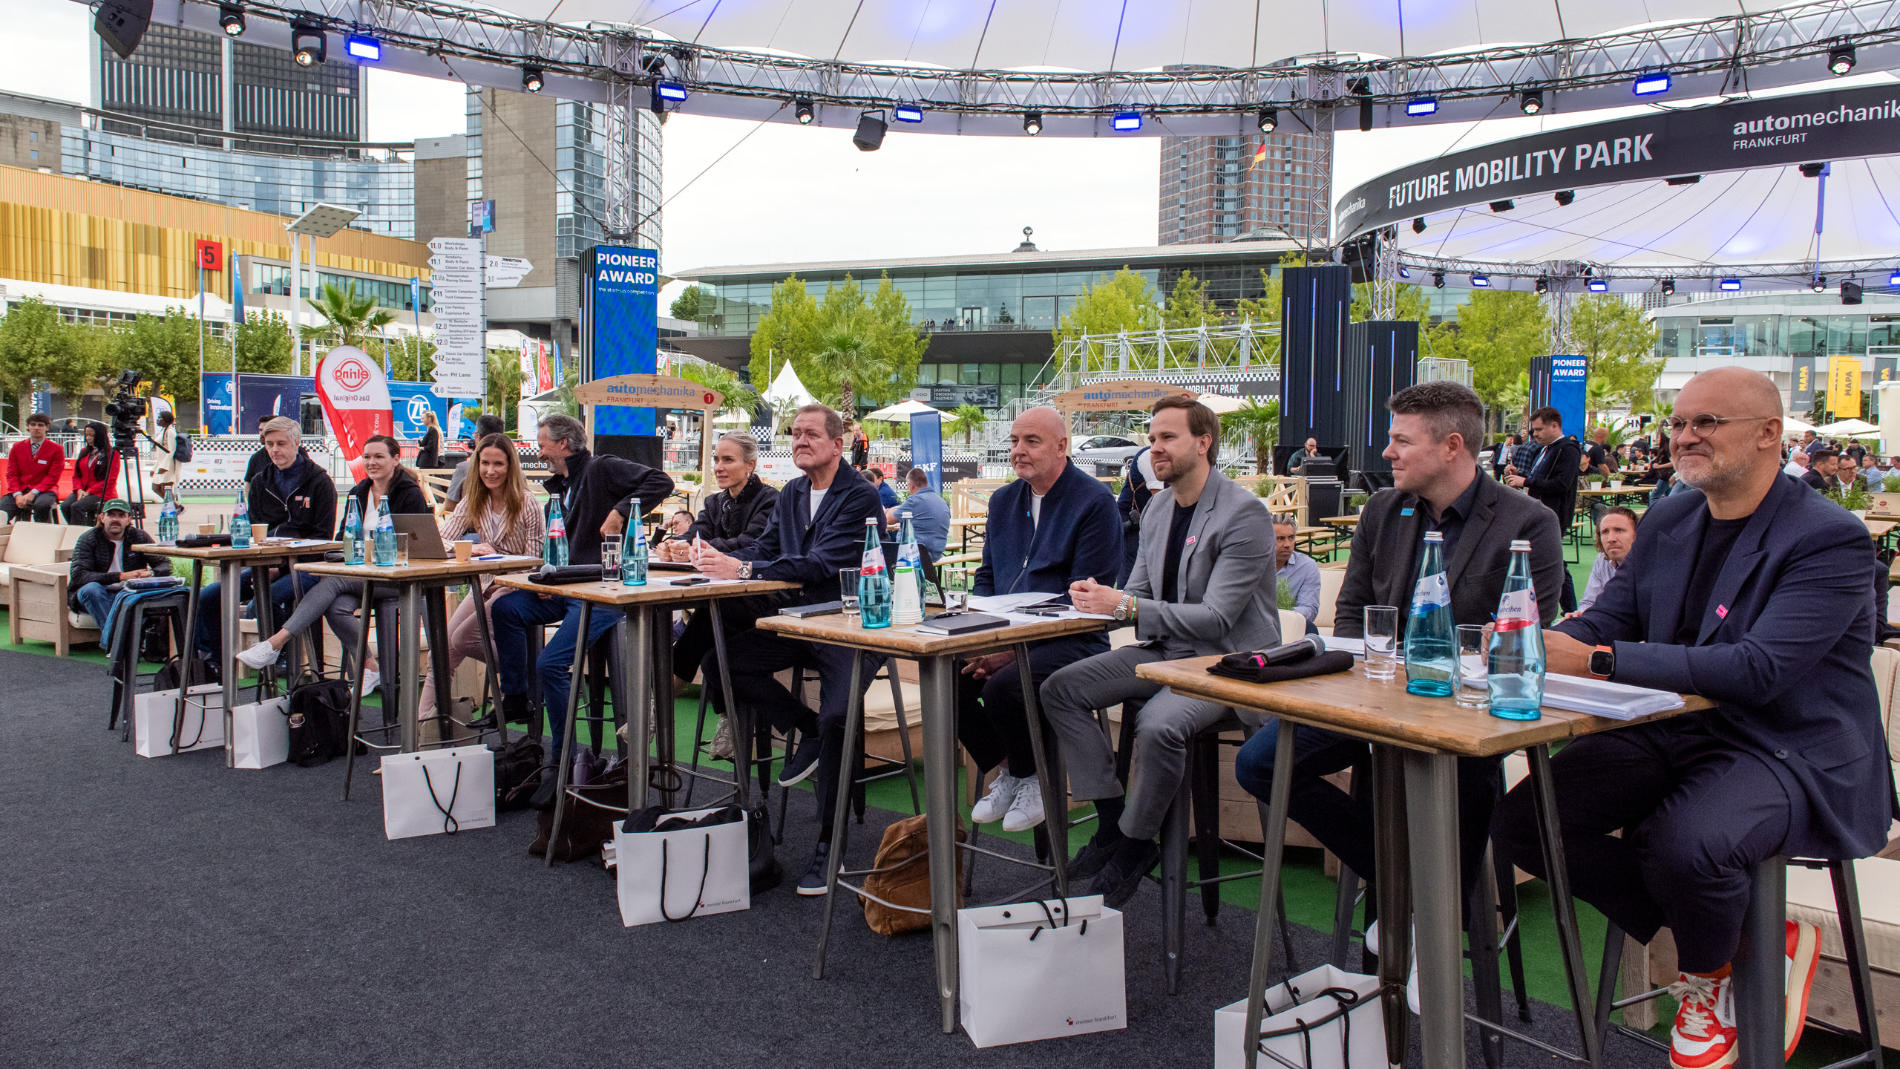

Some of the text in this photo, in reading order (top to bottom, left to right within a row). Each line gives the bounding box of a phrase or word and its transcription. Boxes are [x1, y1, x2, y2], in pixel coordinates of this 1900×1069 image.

[1733, 100, 1900, 135] automechanik
[1733, 133, 1808, 150] FRANKFURT
[1388, 133, 1654, 209] FUTURE MOBILITY PARK
[204, 246, 215, 264] 5
[597, 253, 656, 268] PIONEER
[598, 270, 655, 285] AWARD
[1552, 359, 1586, 367] PIONEER
[1553, 369, 1585, 377] AWARD
[607, 383, 696, 397] automechanika
[1220, 384, 1239, 394] PARK
